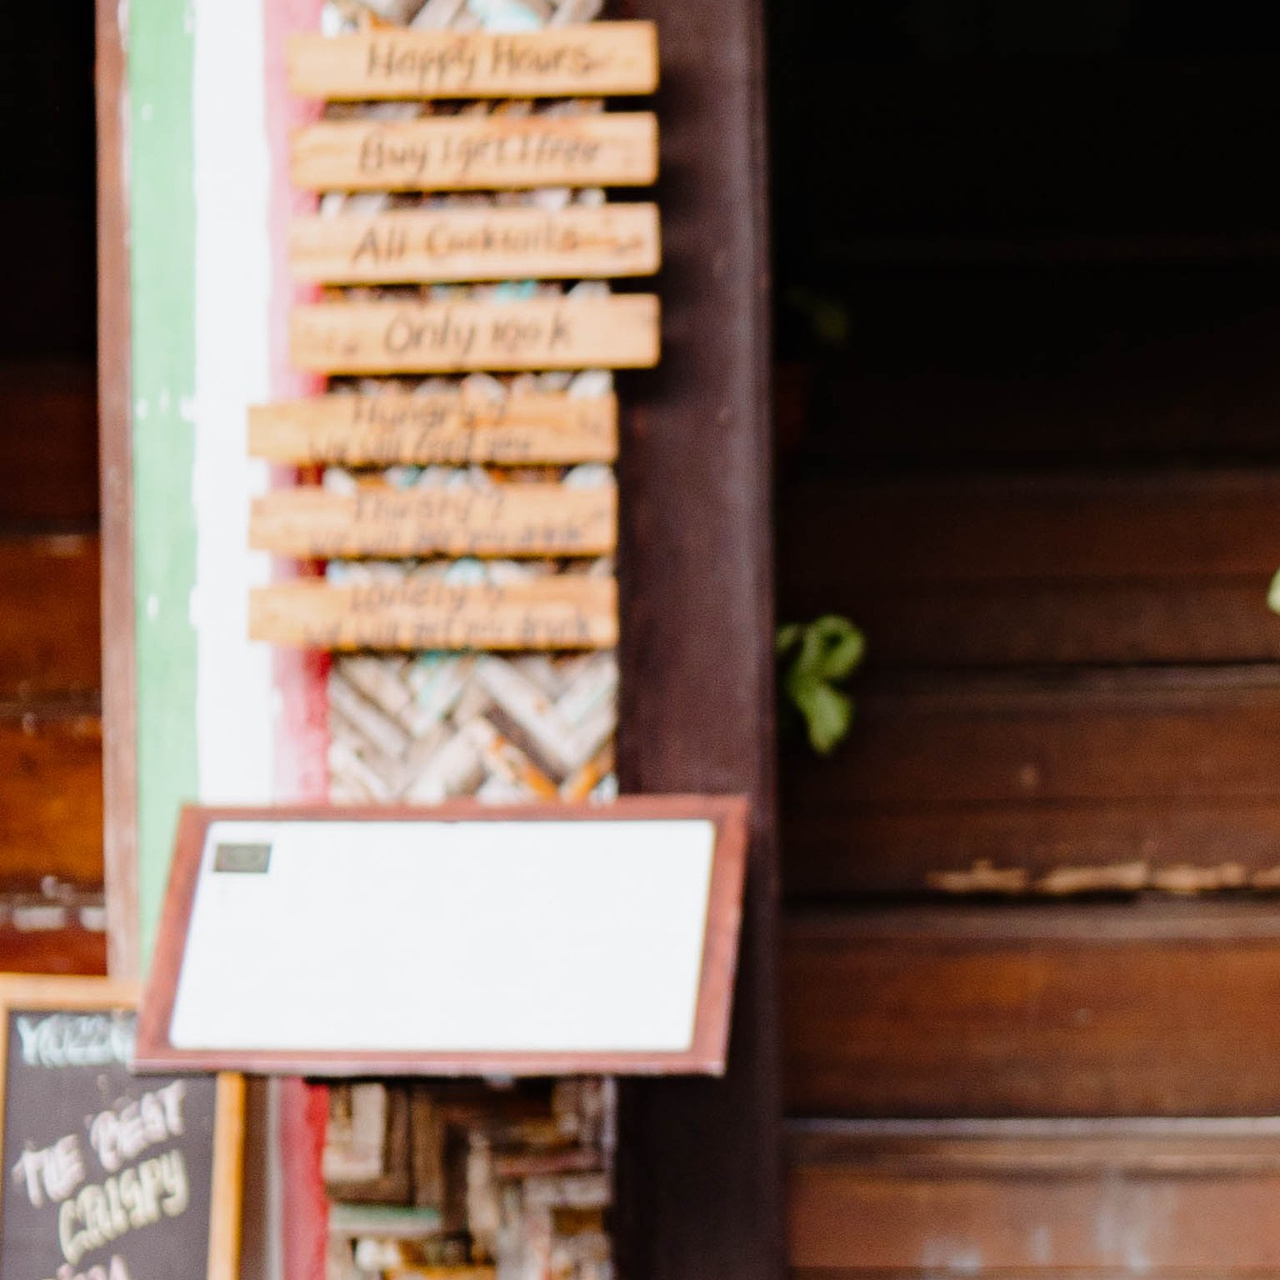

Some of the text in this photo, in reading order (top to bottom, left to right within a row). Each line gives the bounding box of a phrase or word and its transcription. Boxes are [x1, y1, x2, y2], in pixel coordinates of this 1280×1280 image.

[365, 36, 594, 93] Happy Hours
[358, 130, 429, 180] Buy
[350, 224, 408, 268] All
[384, 304, 476, 357] Only
[57, 1150, 189, 1265] CRISPY
